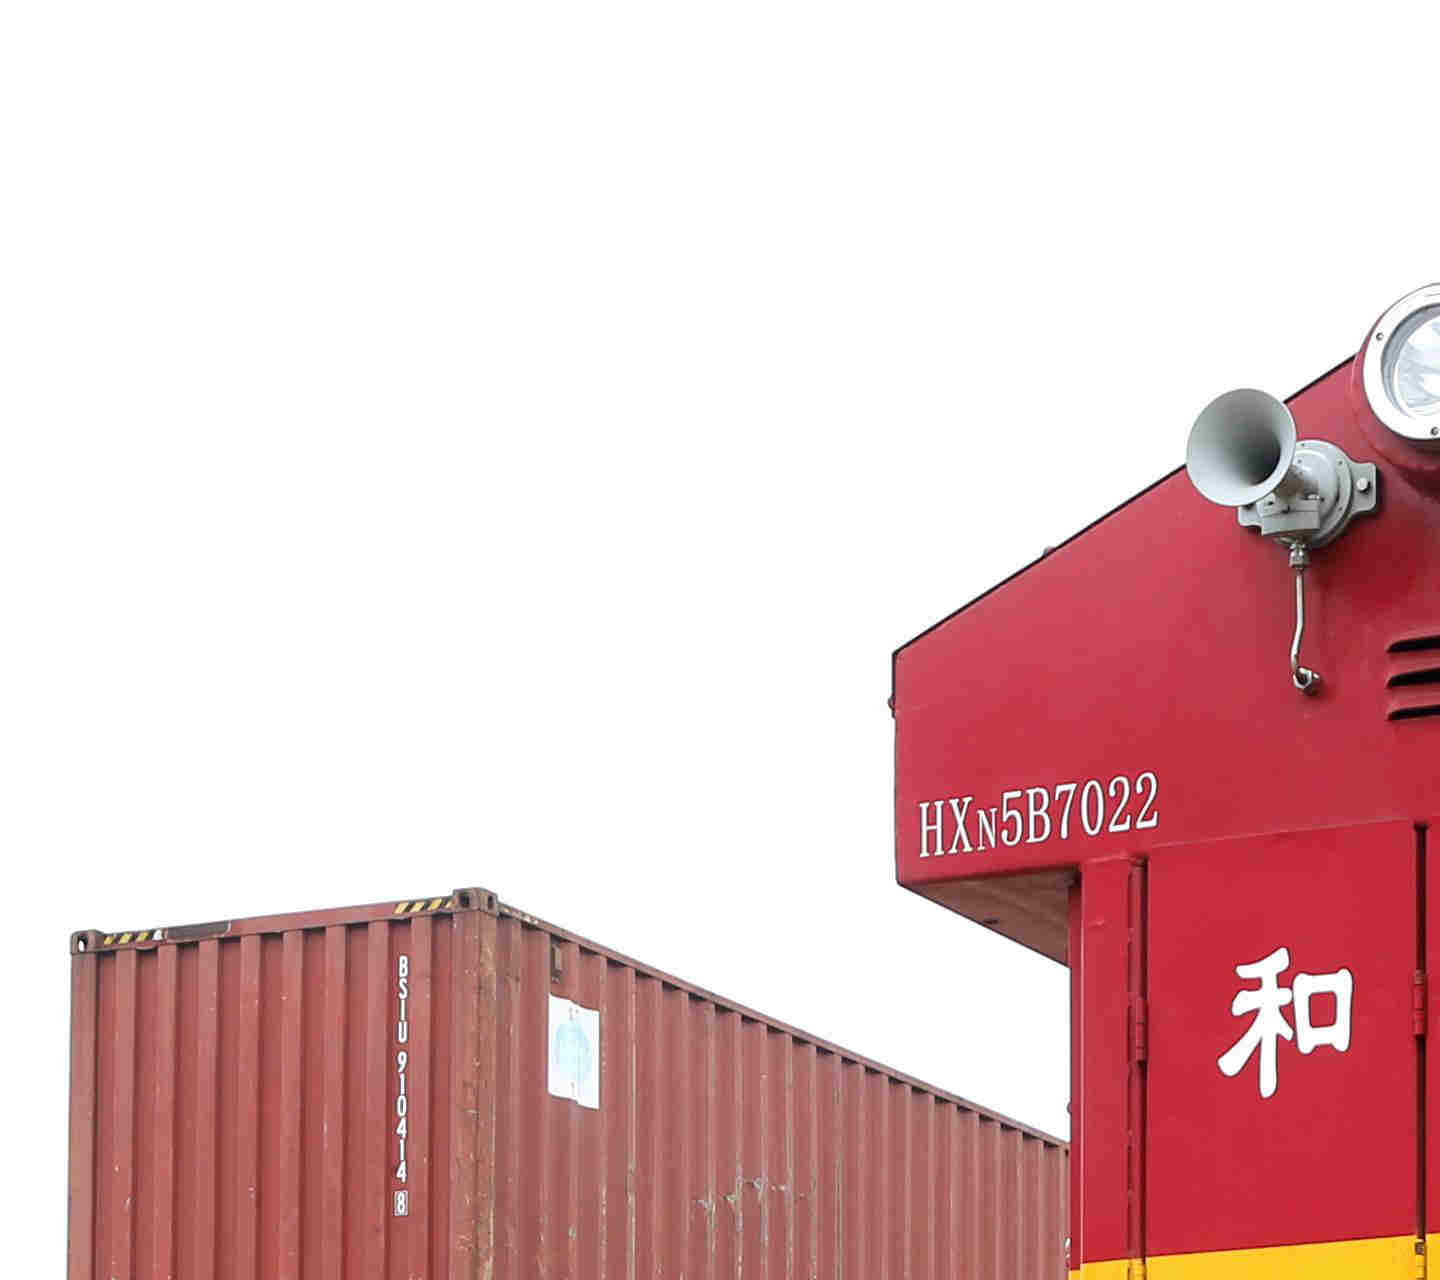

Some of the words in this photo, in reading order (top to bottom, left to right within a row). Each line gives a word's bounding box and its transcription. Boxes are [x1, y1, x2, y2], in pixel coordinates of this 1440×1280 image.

[397, 955, 409, 1043] BSIU
[1217, 946, 1353, 1099] 和
[395, 1051, 408, 1183] 910414
